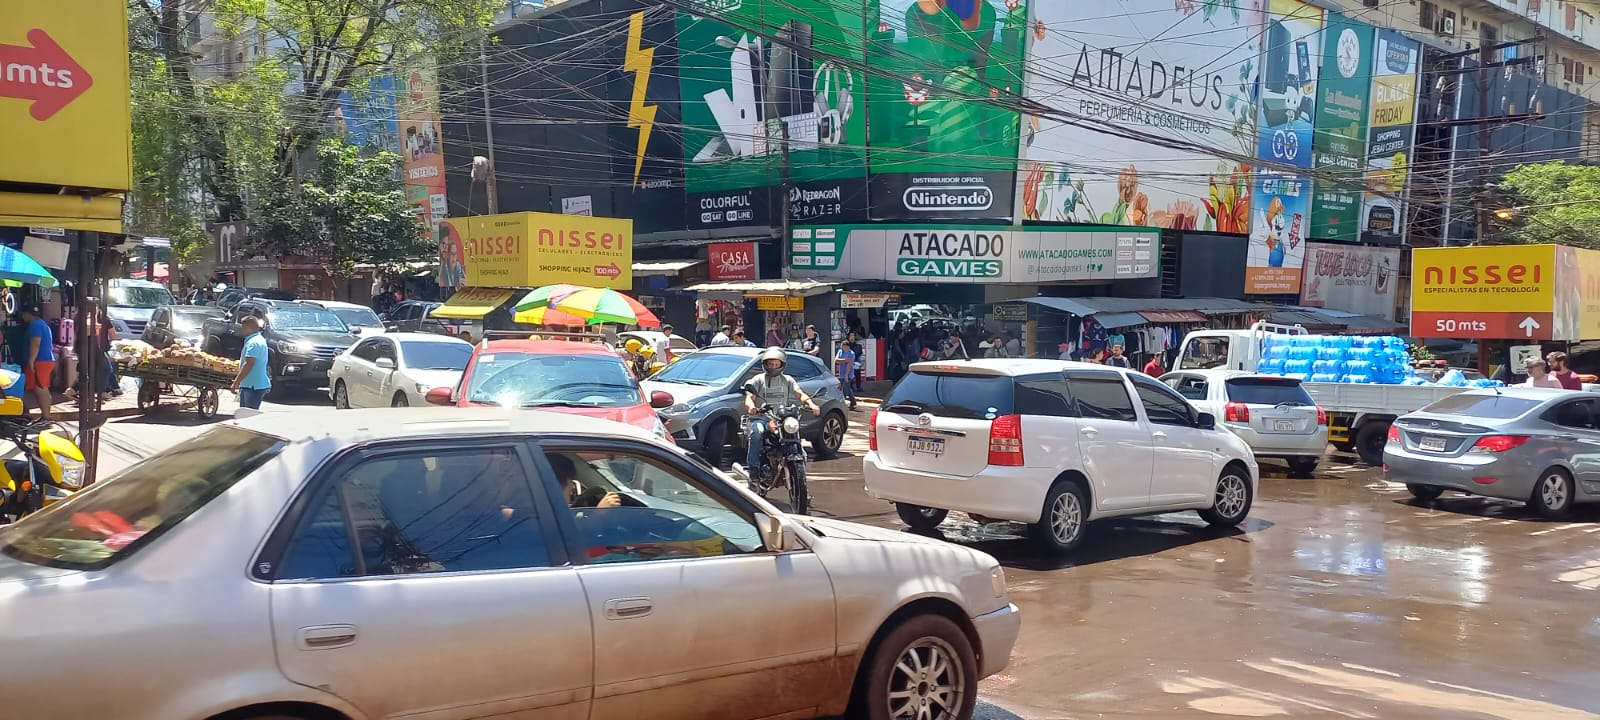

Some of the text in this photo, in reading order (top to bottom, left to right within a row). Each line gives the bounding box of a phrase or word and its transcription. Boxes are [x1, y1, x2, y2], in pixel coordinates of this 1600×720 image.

[1071, 43, 1223, 111] AMADEUS
[1376, 83, 1410, 103] BLACK
[1144, 111, 1151, 124] &
[1374, 105, 1404, 124] FRIDAY
[1376, 129, 1401, 142] SHOPPING
[1385, 140, 1404, 152] CENTER
[802, 185, 840, 203] REDRAGON
[911, 191, 986, 205] Nintendo
[700, 195, 751, 209] COLORFUL
[803, 203, 841, 216] RAZER
[538, 228, 623, 250] nissei
[898, 232, 1004, 257] ATACADO
[720, 251, 750, 264] CASA
[1018, 248, 1113, 260] WWW.ATACADOGAMES.COM
[538, 265, 572, 273] SHOPPING
[573, 266, 592, 274] HIJAZI
[900, 259, 1000, 276] GAMES
[1424, 264, 1541, 285] nissei
[1436, 319, 1487, 332] 50 mts
